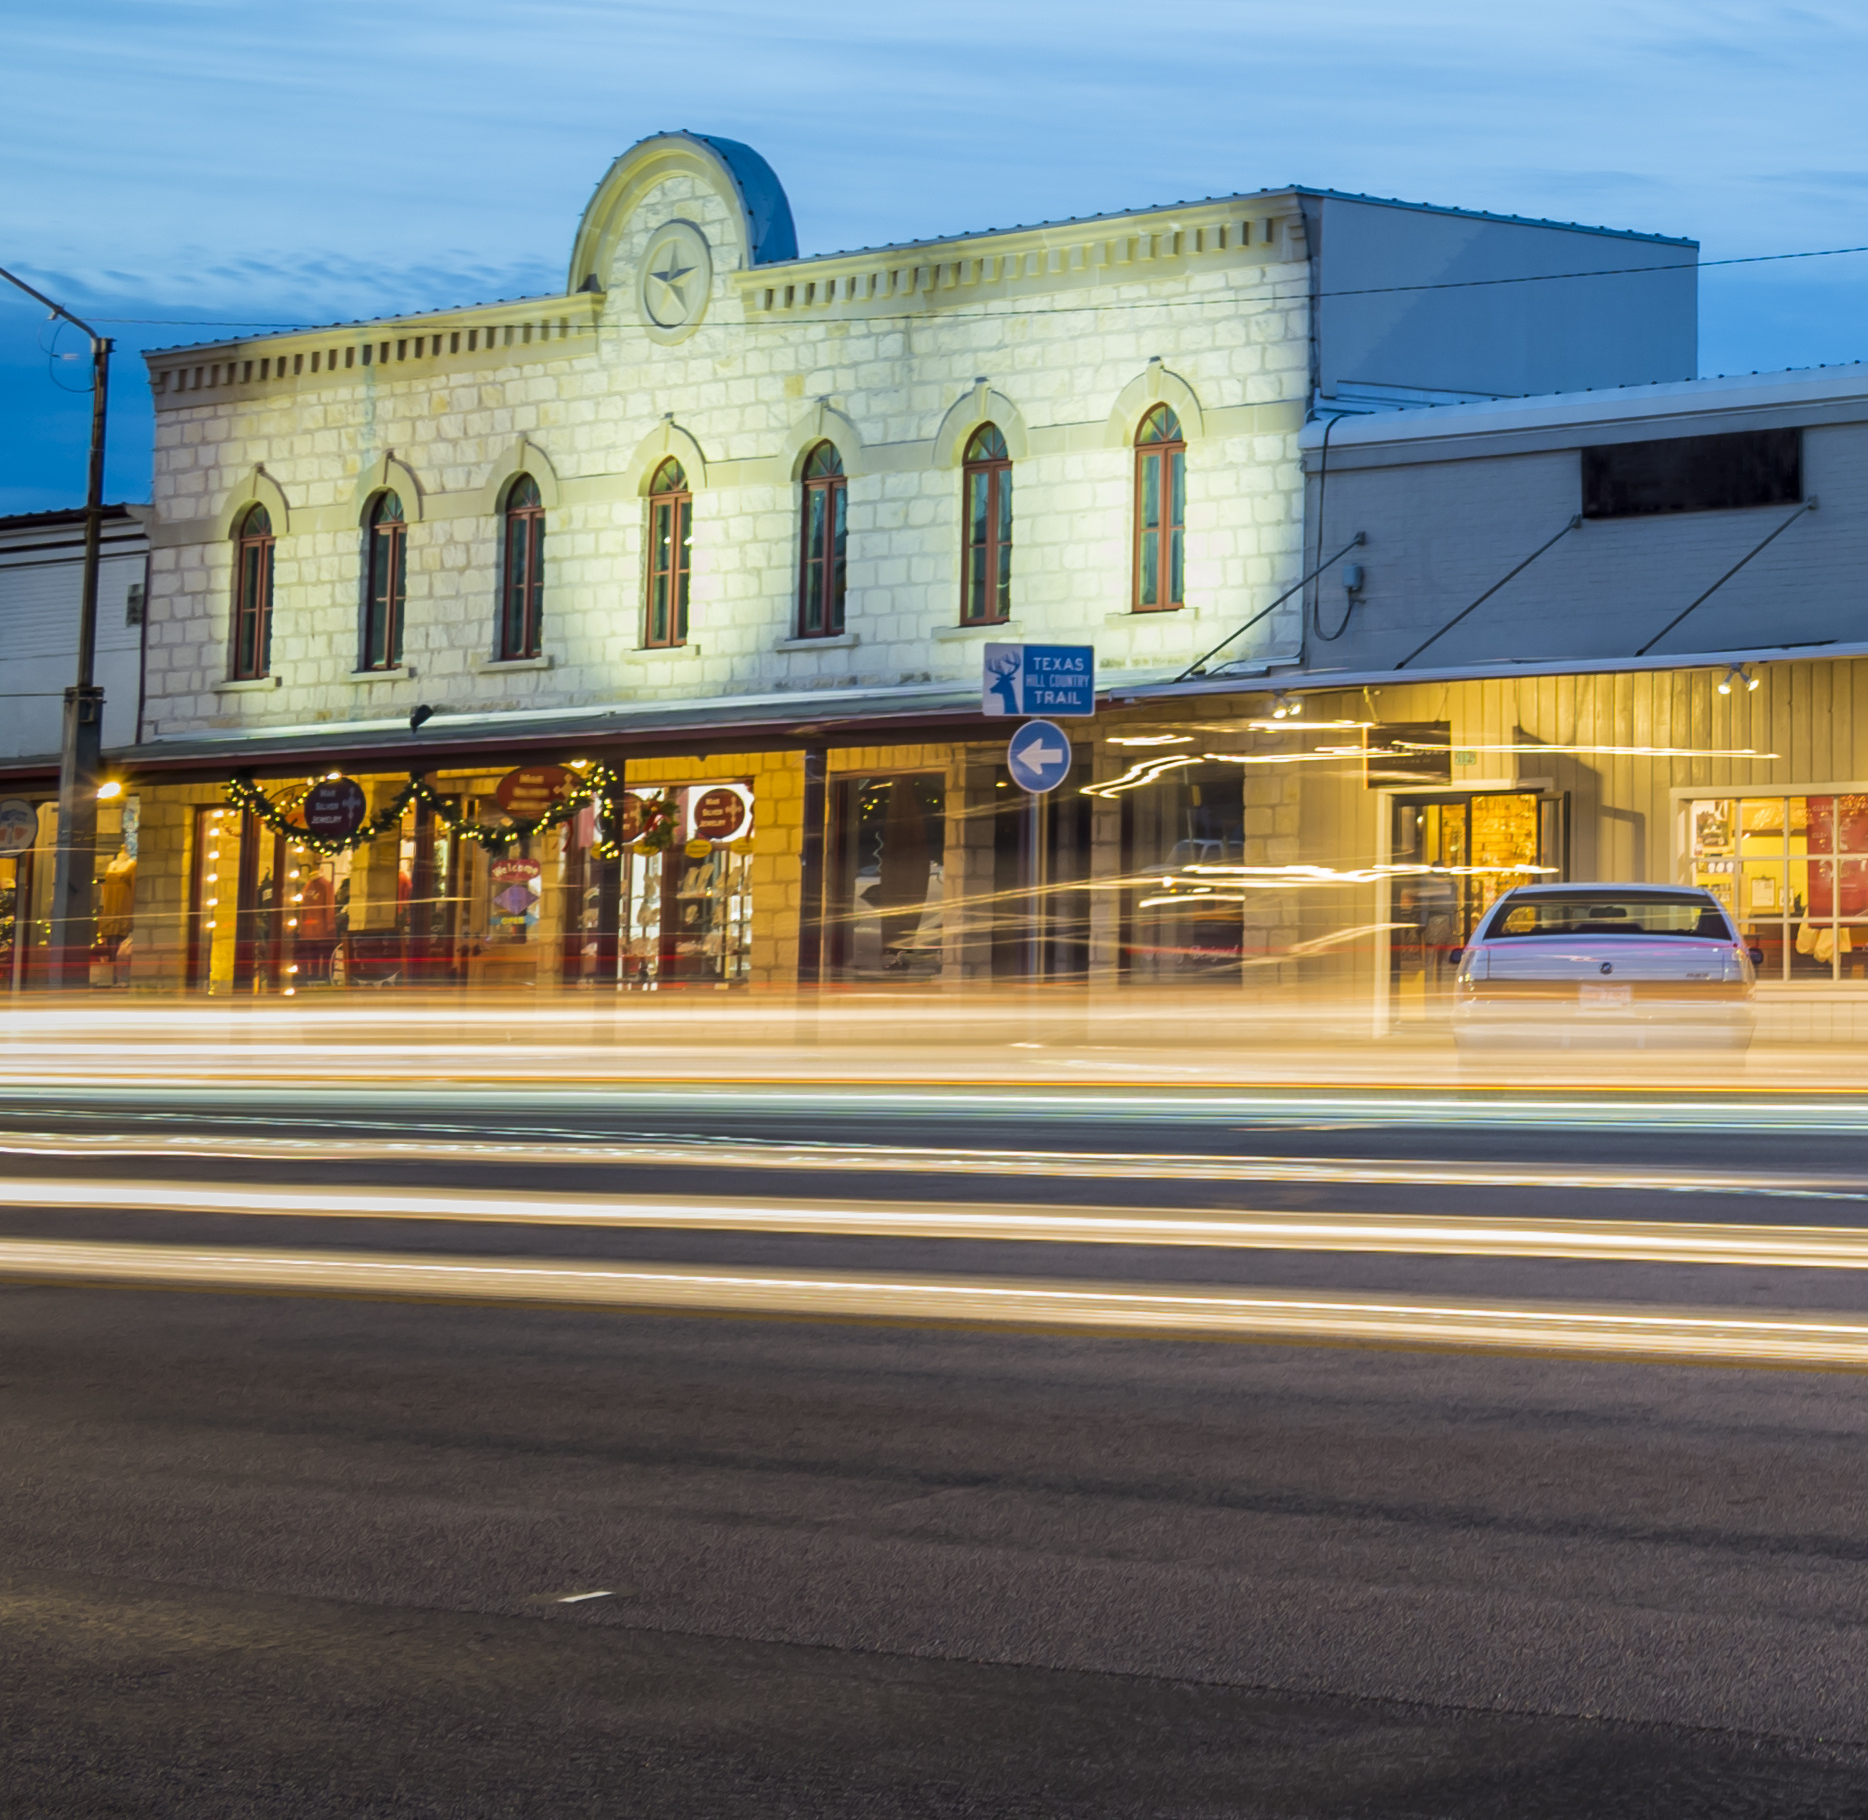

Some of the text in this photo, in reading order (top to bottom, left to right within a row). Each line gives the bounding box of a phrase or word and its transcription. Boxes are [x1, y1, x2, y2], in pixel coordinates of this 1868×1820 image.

[1033, 657, 1085, 671] TEXAS
[1025, 674, 1090, 688] HILL COUNTRY
[1034, 690, 1082, 705] TRAIL
[491, 862, 539, 878] Welcome
